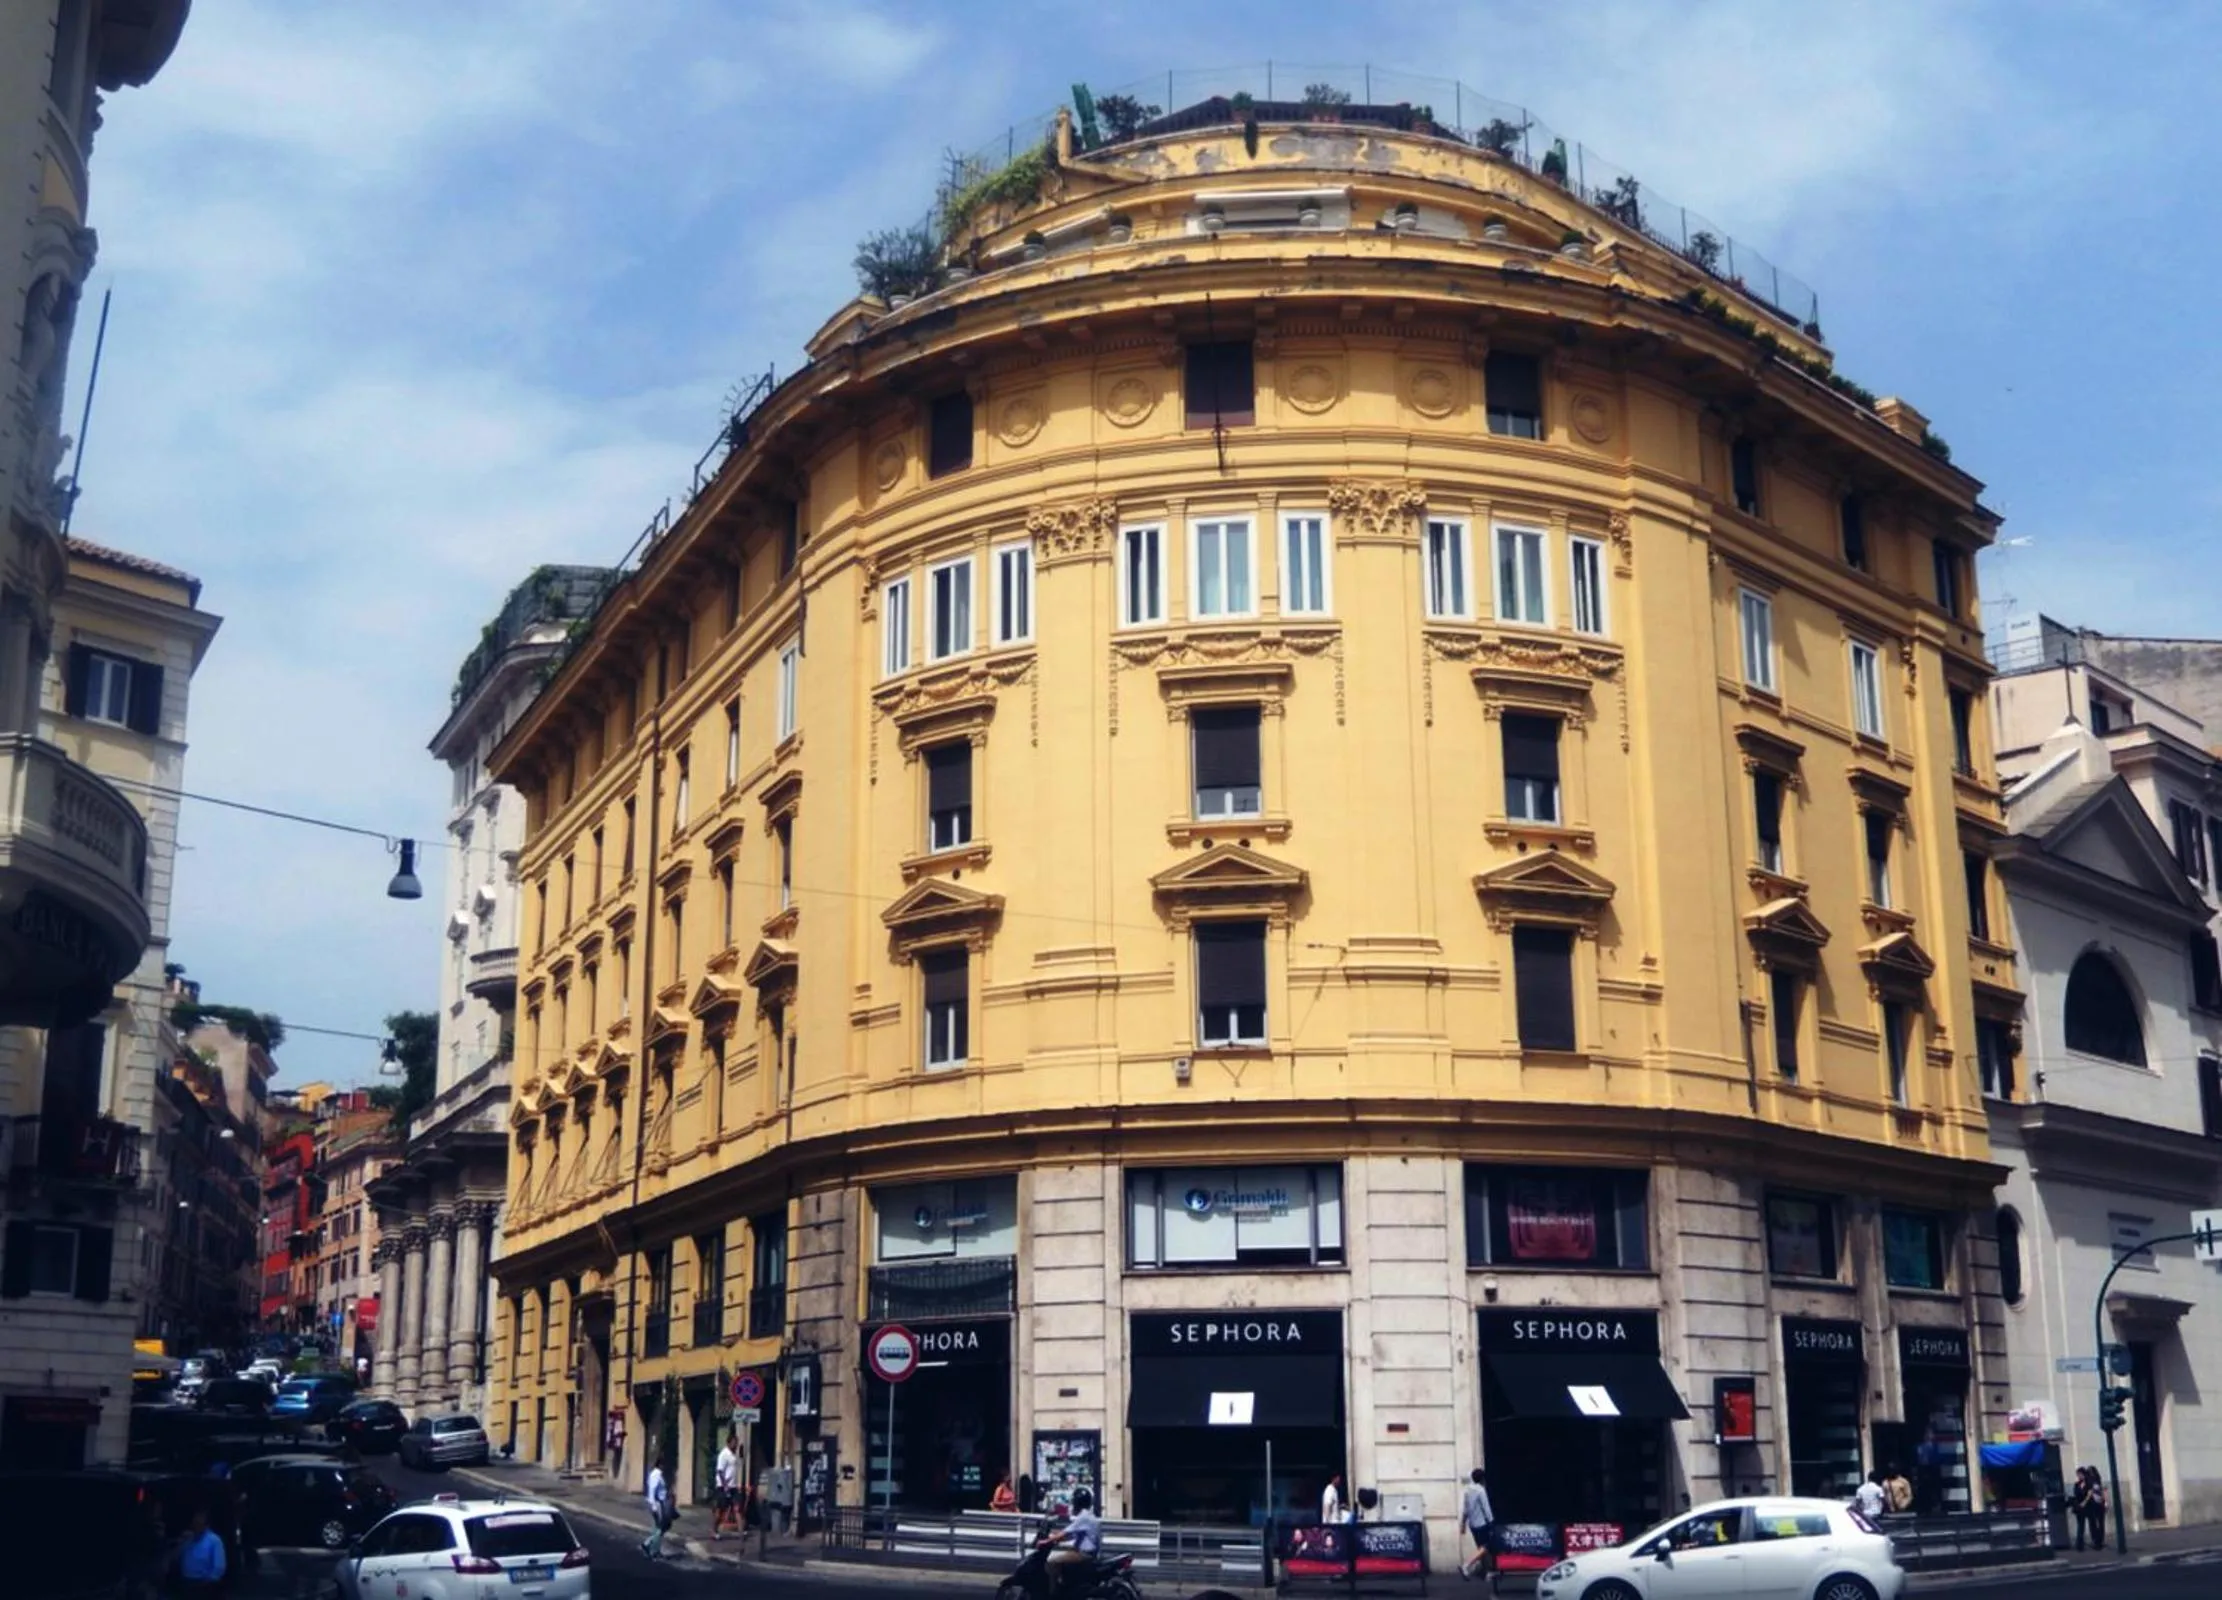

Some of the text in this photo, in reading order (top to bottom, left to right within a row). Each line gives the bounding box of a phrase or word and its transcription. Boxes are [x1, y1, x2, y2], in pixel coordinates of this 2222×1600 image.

[1170, 1323, 1301, 1342] SEPHORA
[1513, 1320, 1626, 1340] SEPHORA
[1794, 1331, 1854, 1349] SEPHORA
[1910, 1338, 1961, 1356] SEPHORA
